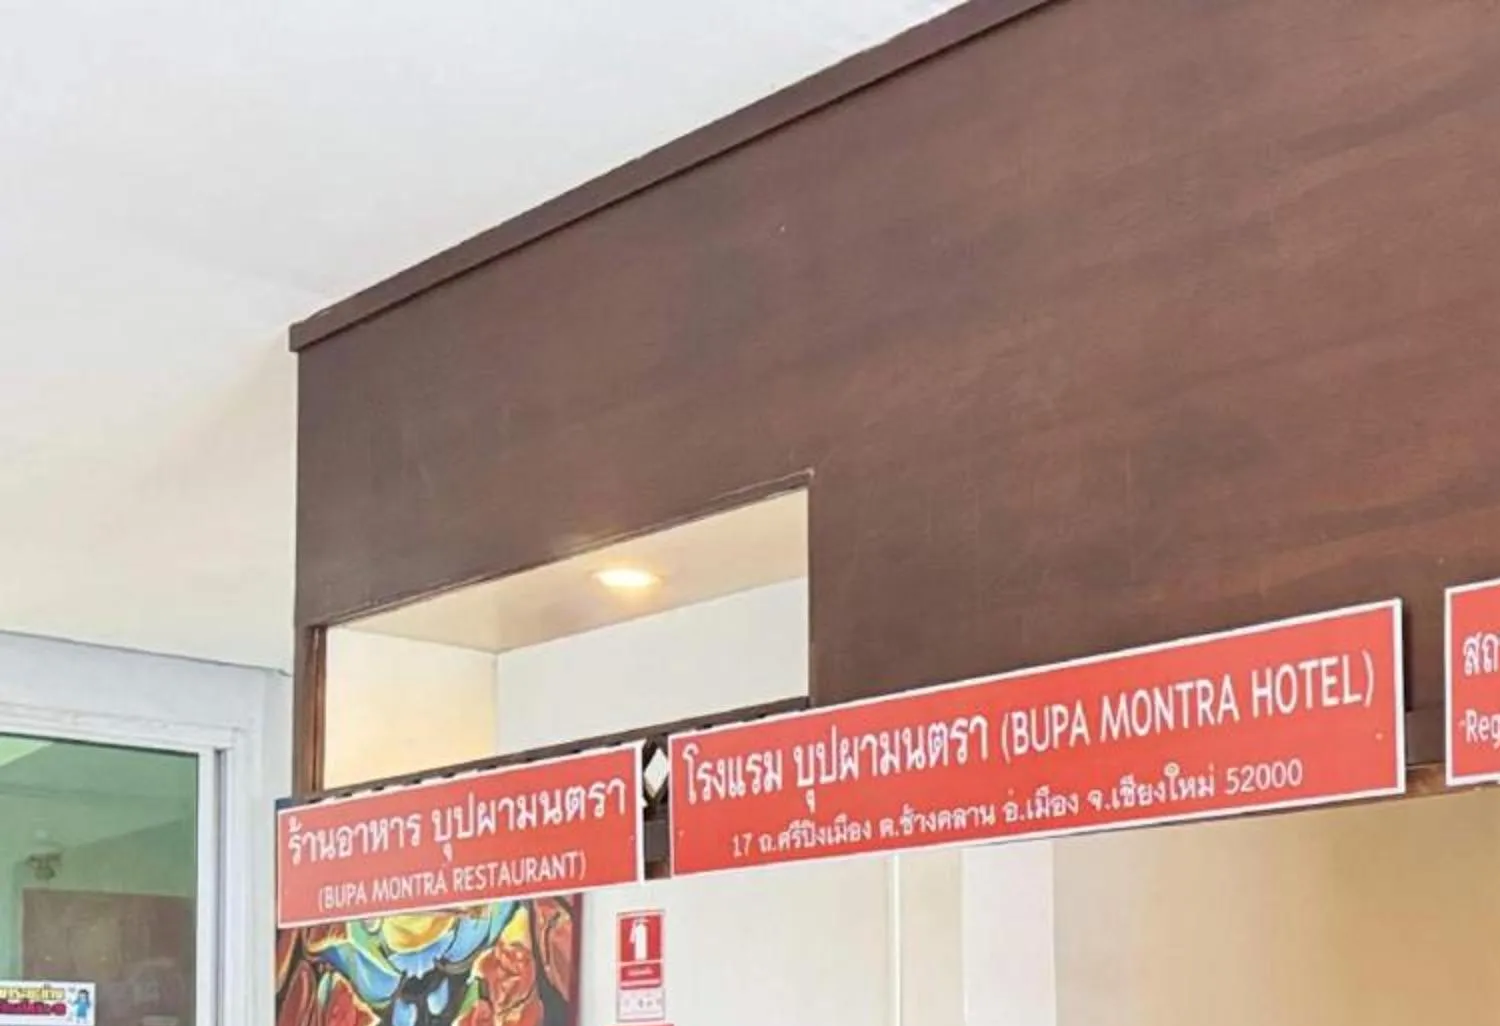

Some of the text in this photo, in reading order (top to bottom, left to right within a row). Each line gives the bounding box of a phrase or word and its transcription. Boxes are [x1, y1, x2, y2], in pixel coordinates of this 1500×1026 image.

[682, 649, 1375, 813] โรงแรม บุปผามนตรา (BUPA MONTRA HOTEL)
[287, 777, 626, 866] ร้านอาหาร บุปผามนตรา
[732, 833, 752, 858] 17
[1226, 759, 1304, 794] 52000
[318, 850, 587, 914] (BUPA MONTRA RESTAURANT)
